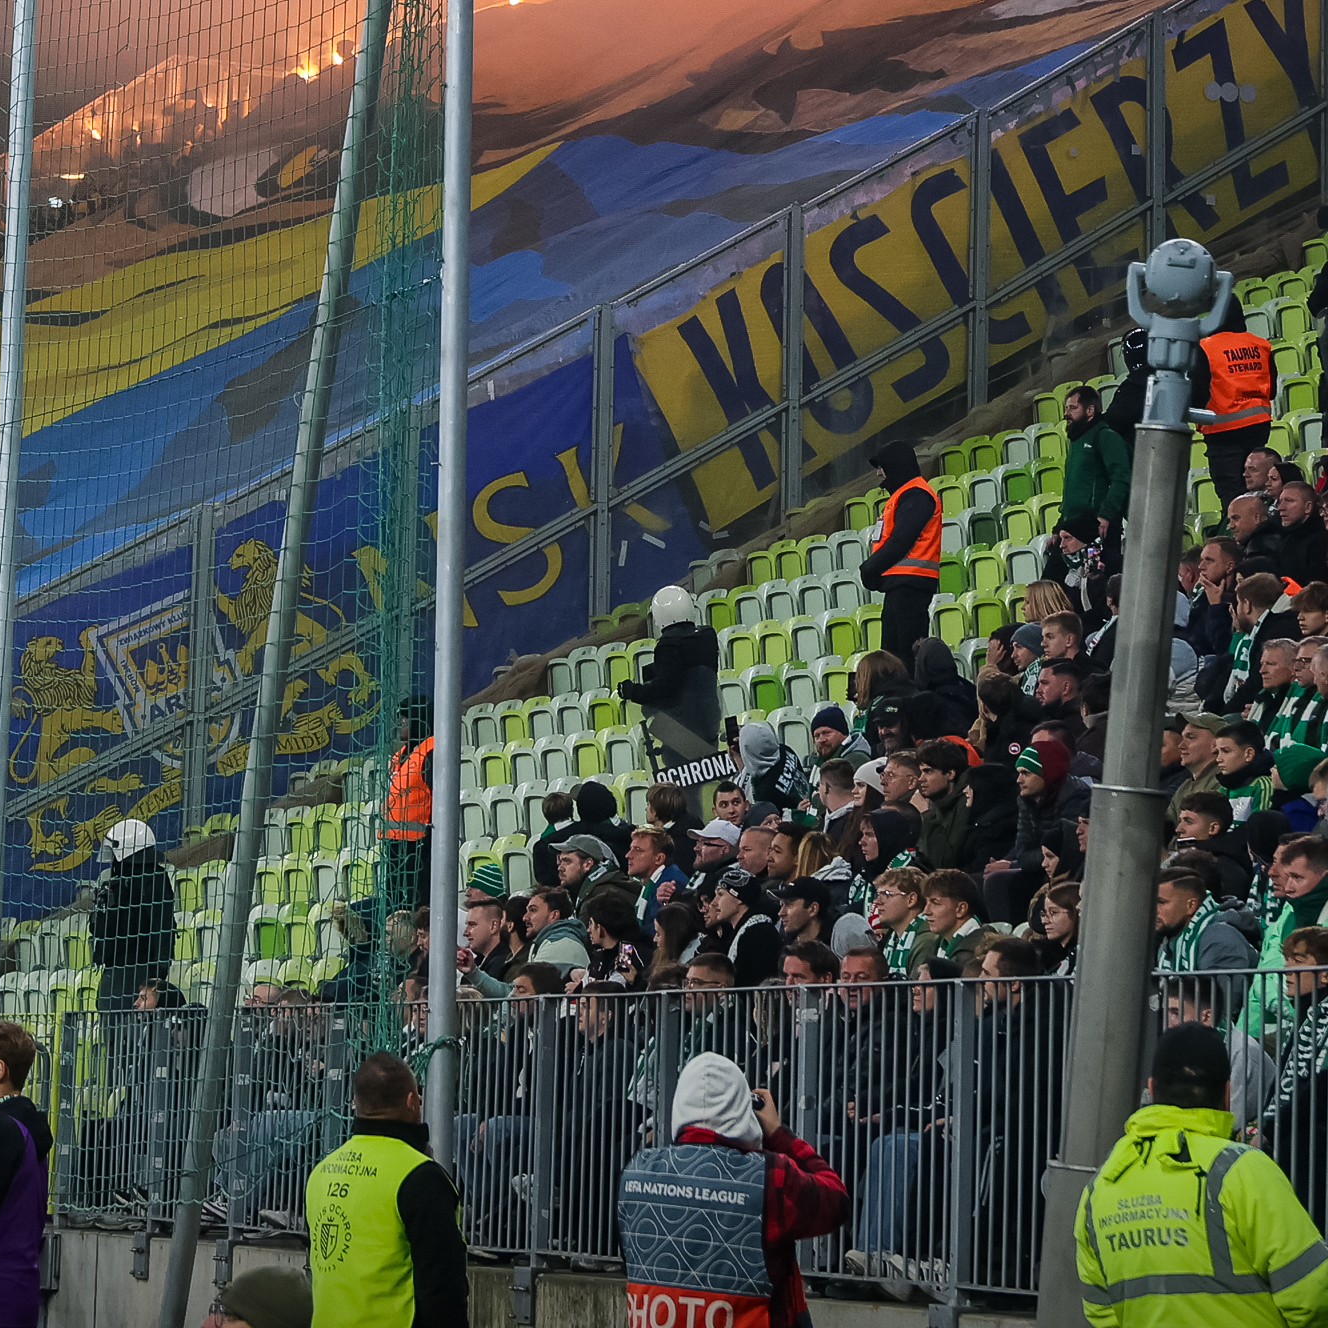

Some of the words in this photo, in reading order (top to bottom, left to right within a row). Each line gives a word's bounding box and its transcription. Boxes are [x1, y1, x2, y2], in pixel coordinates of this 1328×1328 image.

[1223, 346, 1261, 362] TAURUS
[1228, 362, 1262, 373] STEWARD
[657, 753, 737, 787] OCHRONA
[774, 750, 796, 795] LECHIA
[327, 1182, 350, 1198] 126
[642, 1182, 693, 1199] NATIONS
[695, 1188, 746, 1205] LEAGUE
[1105, 1227, 1188, 1252] TAURUS
